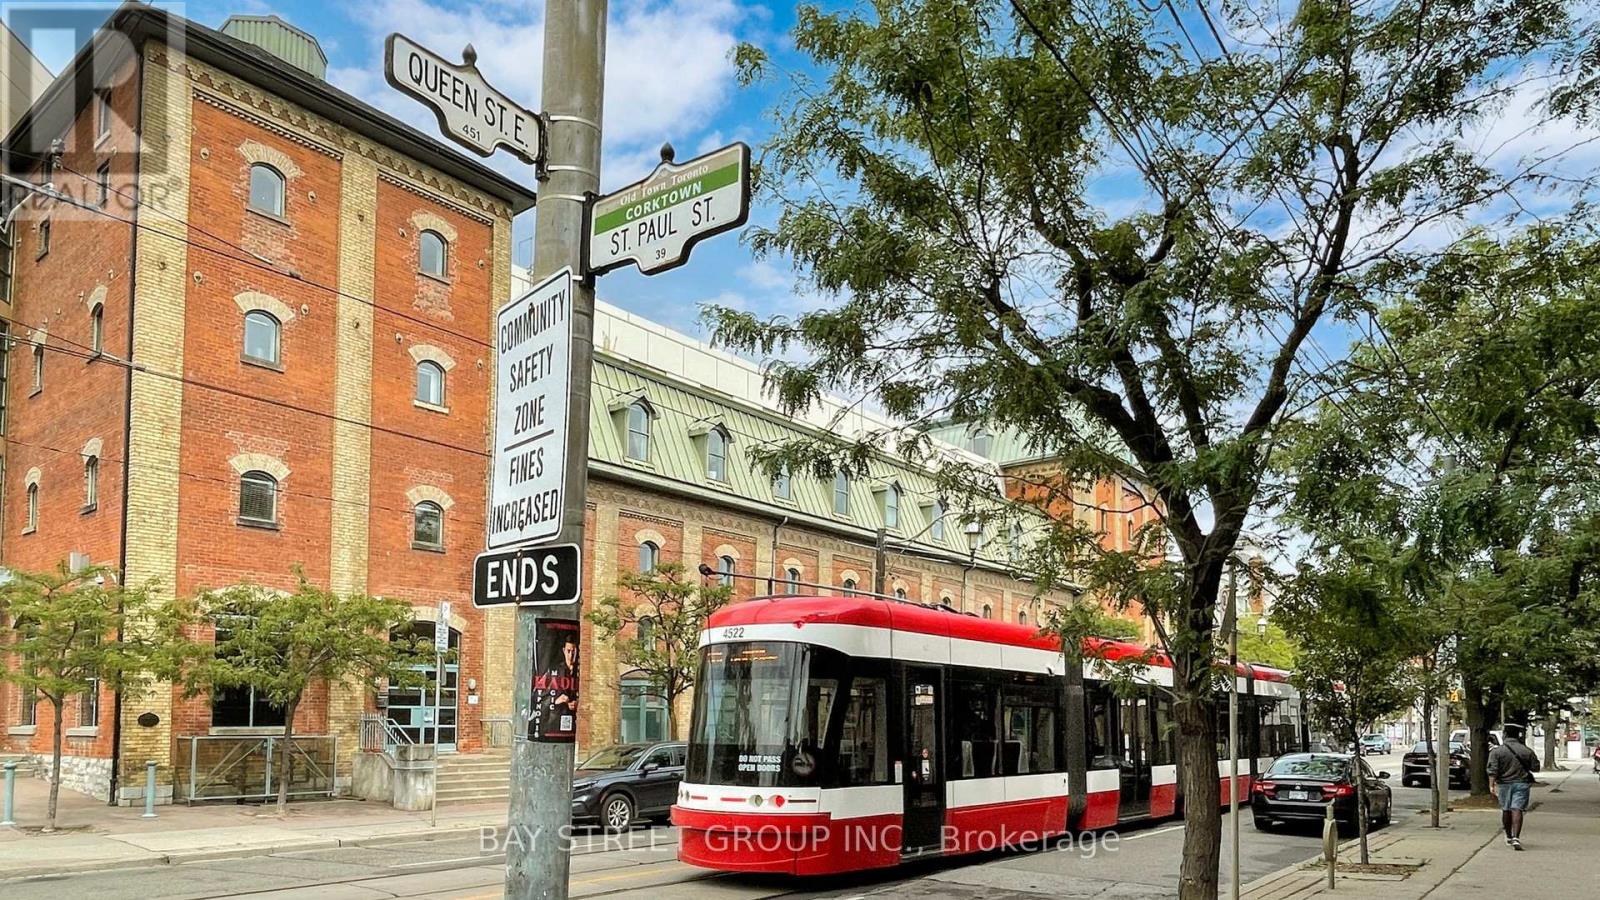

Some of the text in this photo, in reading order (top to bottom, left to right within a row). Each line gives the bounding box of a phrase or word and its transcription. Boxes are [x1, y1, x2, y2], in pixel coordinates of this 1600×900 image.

[408, 51, 529, 148] QUEEN ST. E.
[462, 124, 481, 142] 451
[620, 165, 709, 206] Old Town Toronto
[625, 181, 702, 221] CORKTOWN
[610, 196, 716, 256] ST. PAUL ST.
[655, 247, 667, 260] 39
[500, 289, 566, 355] COMMUNITY
[509, 343, 555, 393] SAFETY
[514, 395, 546, 436] ZONE
[509, 447, 545, 488] FINES
[491, 489, 560, 536] INCREASED
[486, 554, 561, 599] ENDS
[723, 627, 745, 639] 4522
[738, 754, 781, 763] DO NOT PASS
[738, 763, 781, 773] OPEN DOORS
